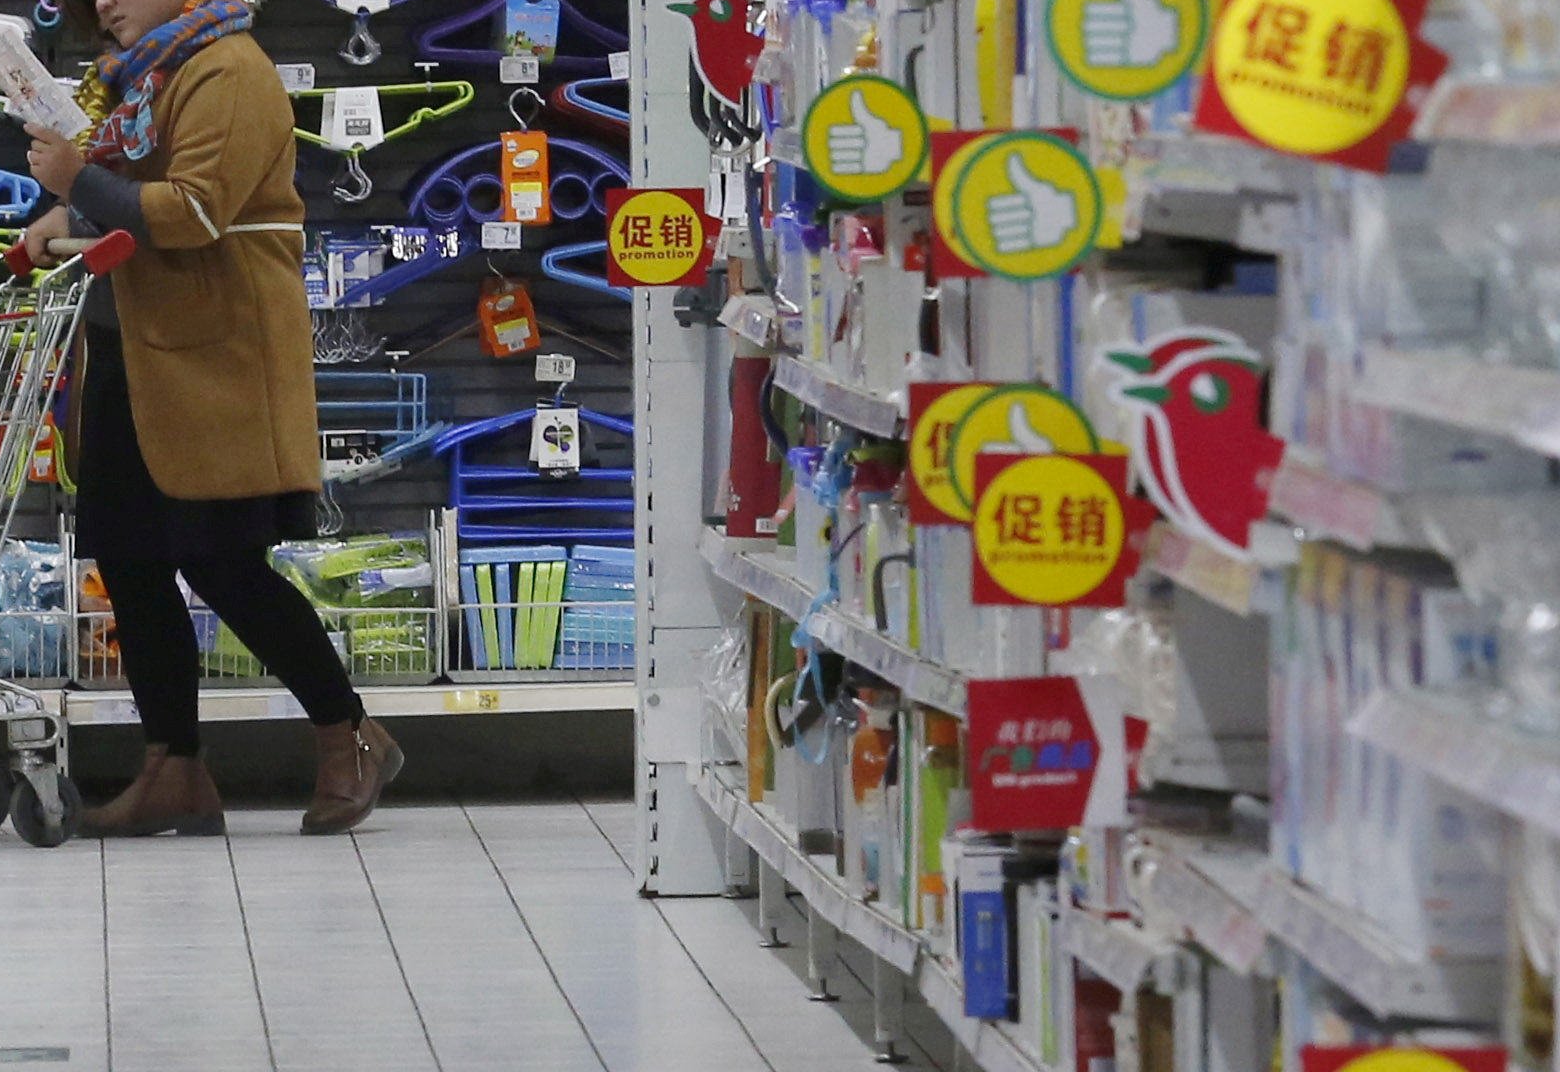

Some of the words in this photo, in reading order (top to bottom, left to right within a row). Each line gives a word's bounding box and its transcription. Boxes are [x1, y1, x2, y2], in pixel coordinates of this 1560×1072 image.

[619, 214, 694, 248] 促销
[619, 248, 694, 262] promotion
[995, 495, 1108, 547] 促销
